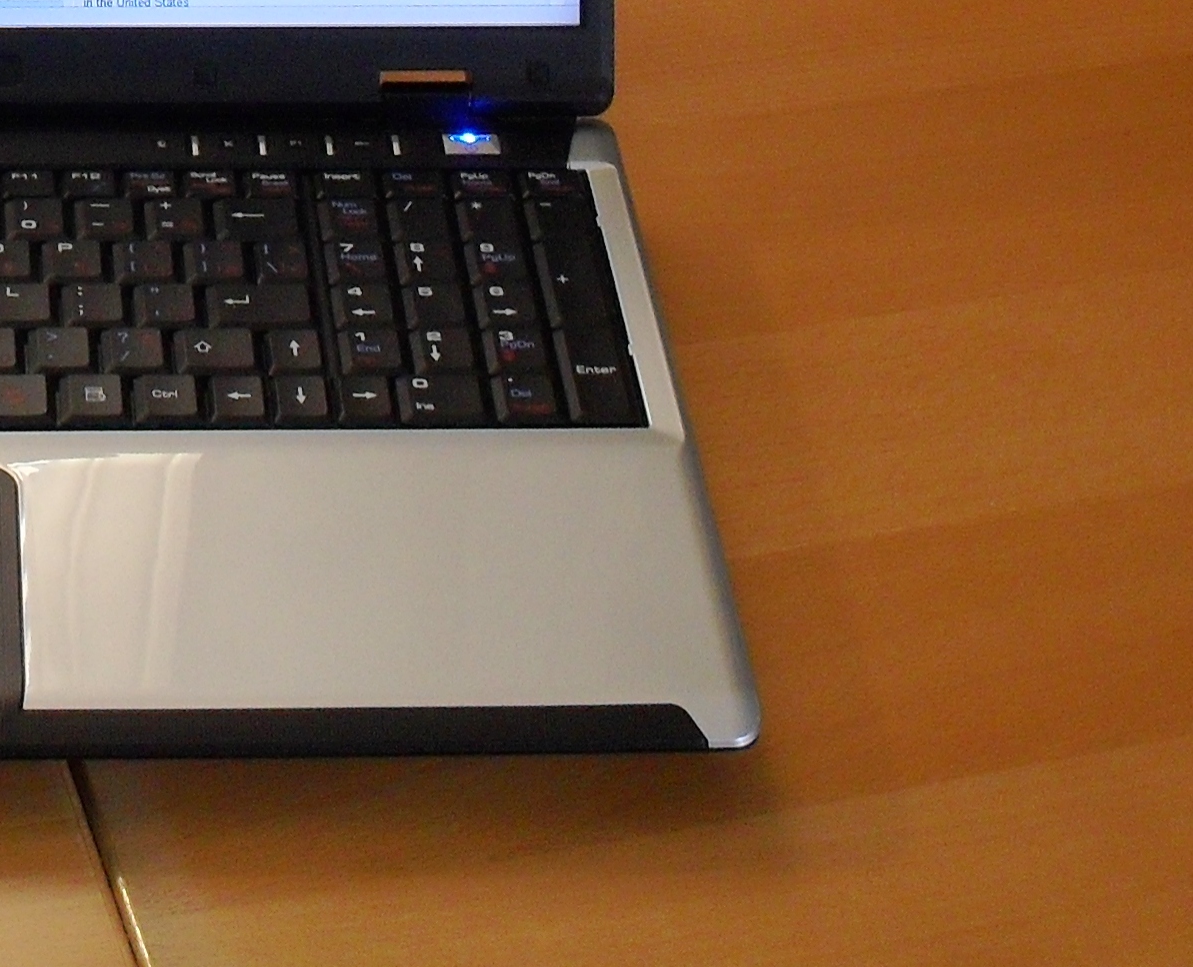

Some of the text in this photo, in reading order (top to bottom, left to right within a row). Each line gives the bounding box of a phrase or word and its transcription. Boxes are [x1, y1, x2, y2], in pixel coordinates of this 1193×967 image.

[57, 242, 74, 253] P
[5, 286, 20, 298] L
[575, 364, 617, 375] Enter
[151, 389, 179, 399] Ctrl
